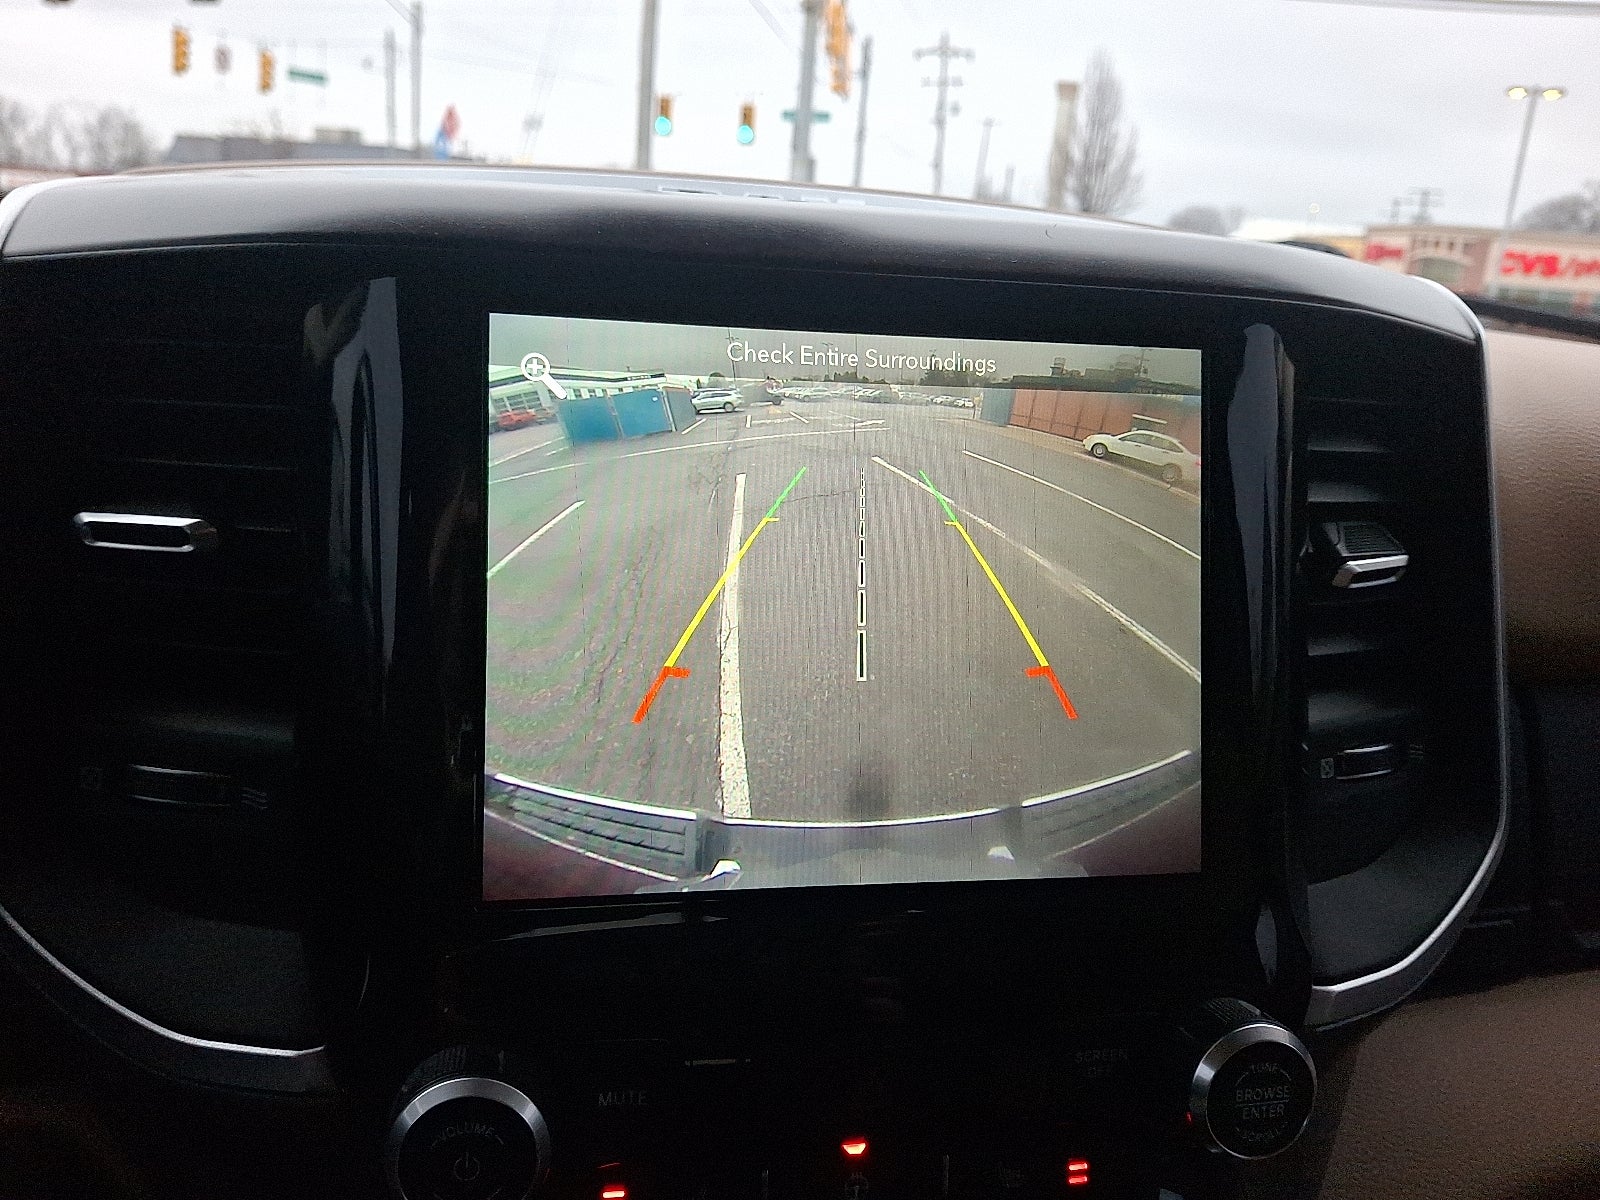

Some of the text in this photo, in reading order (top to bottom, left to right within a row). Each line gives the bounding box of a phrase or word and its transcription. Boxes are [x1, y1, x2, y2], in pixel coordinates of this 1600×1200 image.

[727, 341, 997, 375] Check Entire Surroundings
[598, 1089, 648, 1108] MUTE
[1235, 1085, 1290, 1102] BROWSE
[1242, 1103, 1285, 1120] ENTER
[437, 1121, 495, 1141] VOLUME
